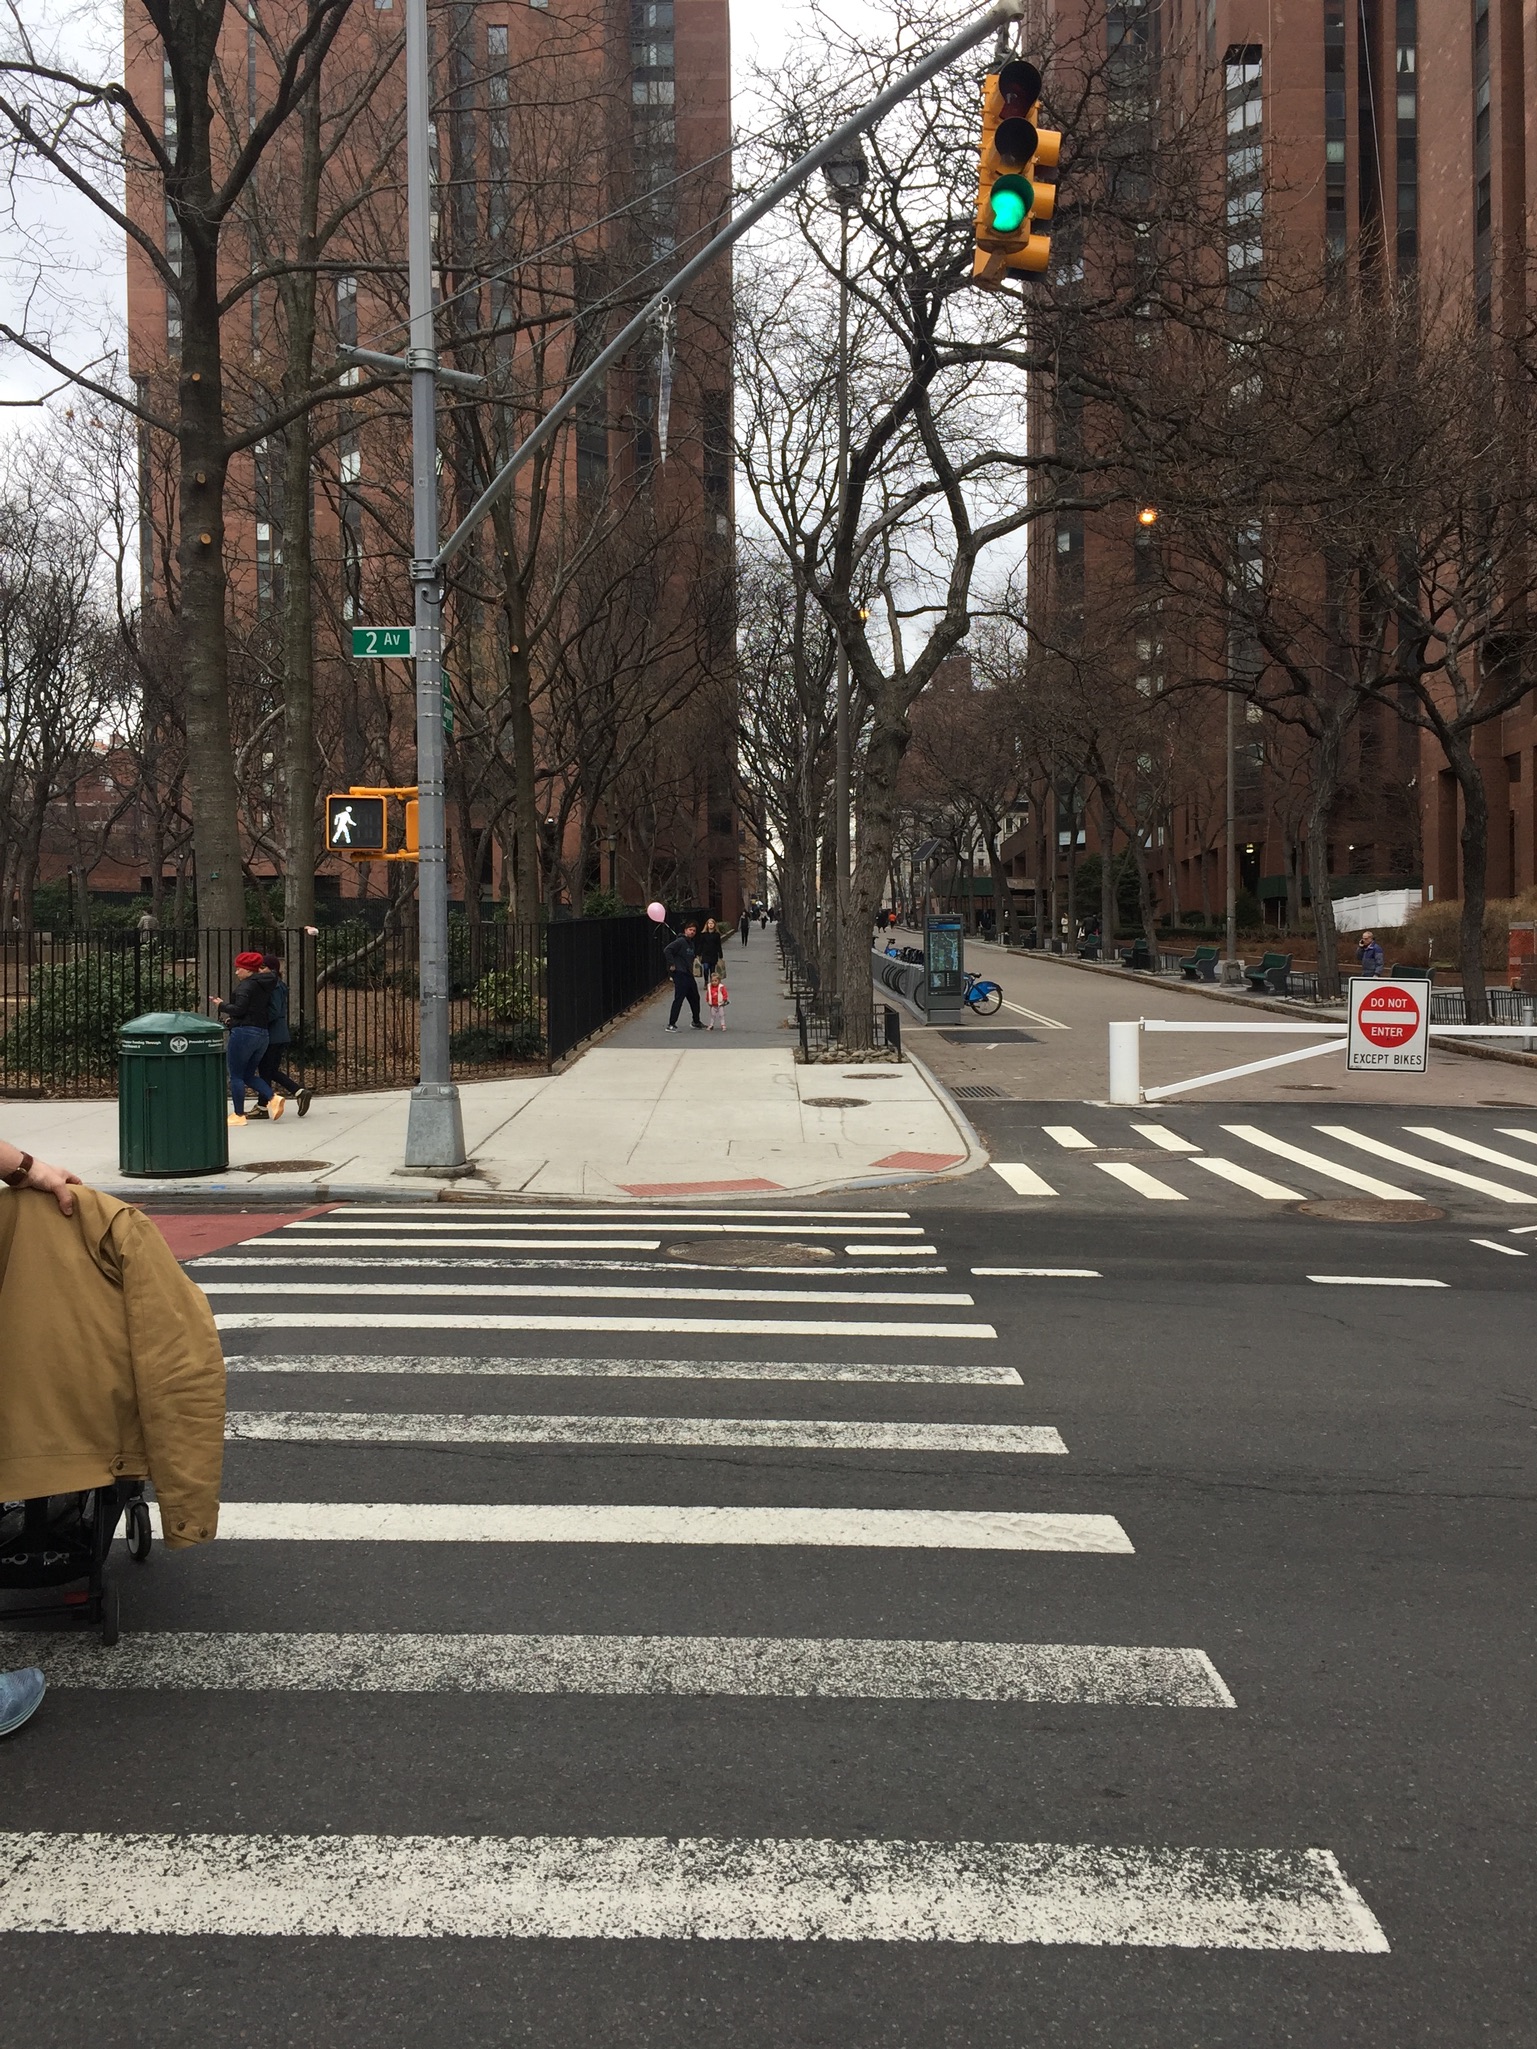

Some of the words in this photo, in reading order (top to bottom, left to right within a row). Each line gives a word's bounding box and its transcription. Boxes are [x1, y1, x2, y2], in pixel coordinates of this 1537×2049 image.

[366, 631, 378, 654] 2
[383, 632, 401, 646] Av
[1370, 998, 1384, 1008] DO
[1388, 998, 1408, 1008] NOT
[1371, 1026, 1403, 1037] ENTER
[1353, 1053, 1389, 1064] EXCEPT
[1394, 1054, 1422, 1065] BIKES
